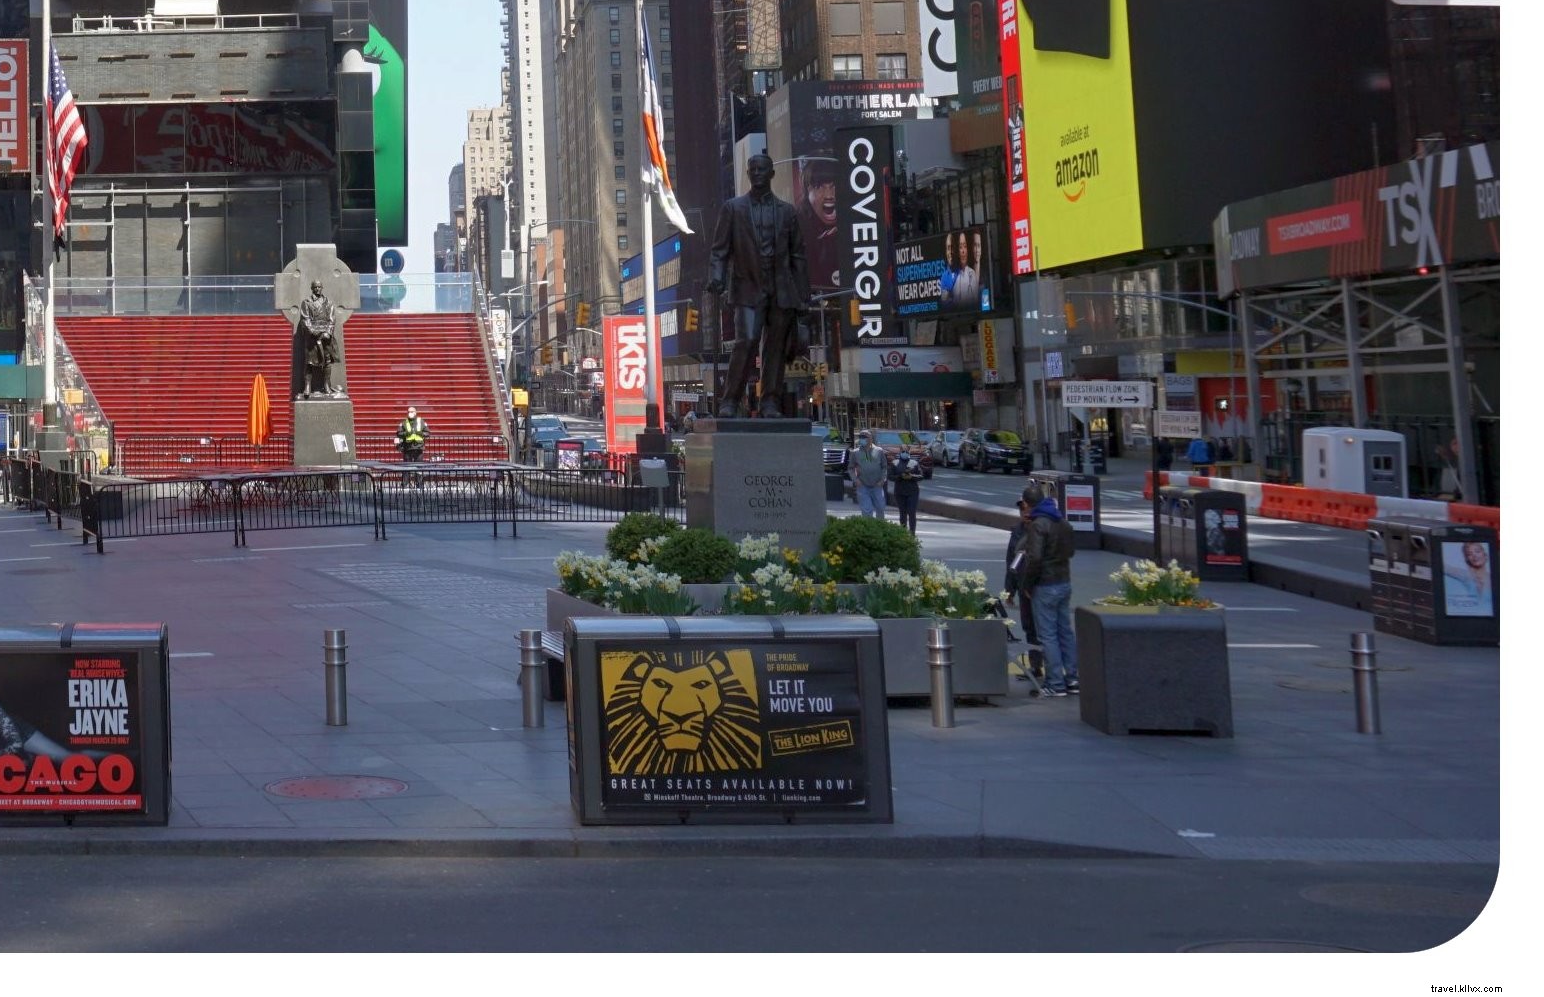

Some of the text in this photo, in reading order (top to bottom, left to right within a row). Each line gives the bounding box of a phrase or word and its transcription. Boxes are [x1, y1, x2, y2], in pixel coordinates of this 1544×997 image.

[972, 76, 990, 94] EVERY
[861, 110, 902, 119] FORT SALEM
[1060, 124, 1090, 147] available at
[1055, 146, 1100, 188] amazon
[1378, 155, 1444, 268] TSX
[896, 244, 924, 265] NOT ALL
[897, 259, 946, 283] SUPERHEROES
[897, 278, 942, 301] WEAR CAPES
[983, 321, 997, 370] LUGGAGE
[617, 322, 647, 390] tkts
[1066, 385, 1140, 393] PEDESTRIAN FLOW ZONE
[1166, 376, 1193, 385] BAGS
[744, 475, 794, 486] GEORGE
[765, 488, 776, 497] M
[748, 497, 793, 508] COHAN
[766, 653, 797, 662] THE PRIDE
[767, 663, 809, 672] OF BROADWAY
[68, 679, 129, 707] ERIKA
[768, 679, 805, 695] LET IT
[770, 697, 833, 713] MOVE YOU
[69, 709, 130, 735] JAYNE
[774, 728, 848, 750] THE LION KING
[611, 779, 854, 790] GREAT SEATS AVAILABLE NOW!
[653, 793, 681, 801] Minskoff
[707, 793, 736, 803] Broadway
[759, 793, 767, 801] St.
[782, 793, 821, 803] lionking.com
